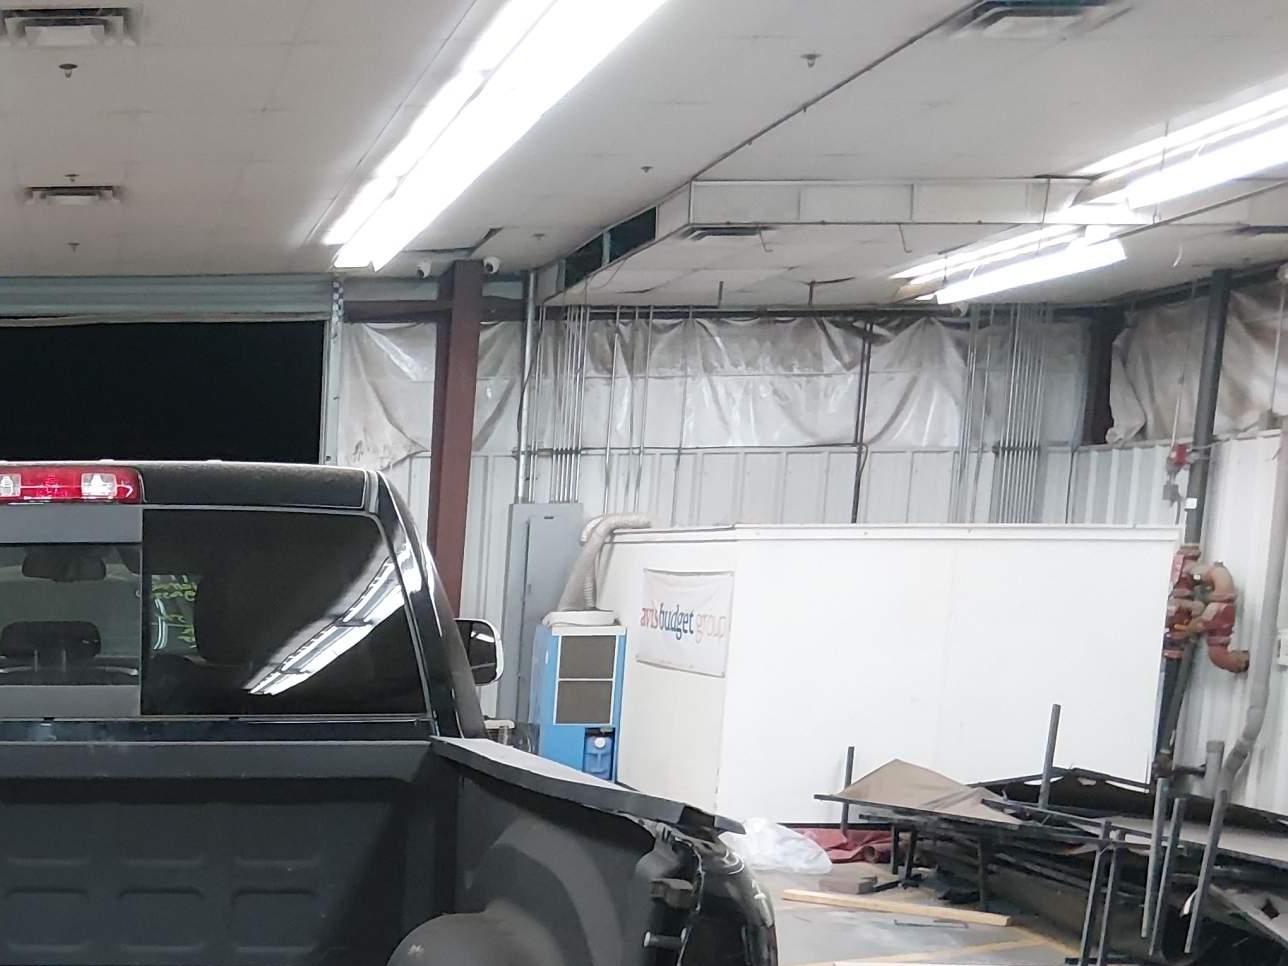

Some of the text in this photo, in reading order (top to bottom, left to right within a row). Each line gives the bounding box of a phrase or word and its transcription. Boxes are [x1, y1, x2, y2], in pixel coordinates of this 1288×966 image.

[639, 601, 727, 645] avis budget group
